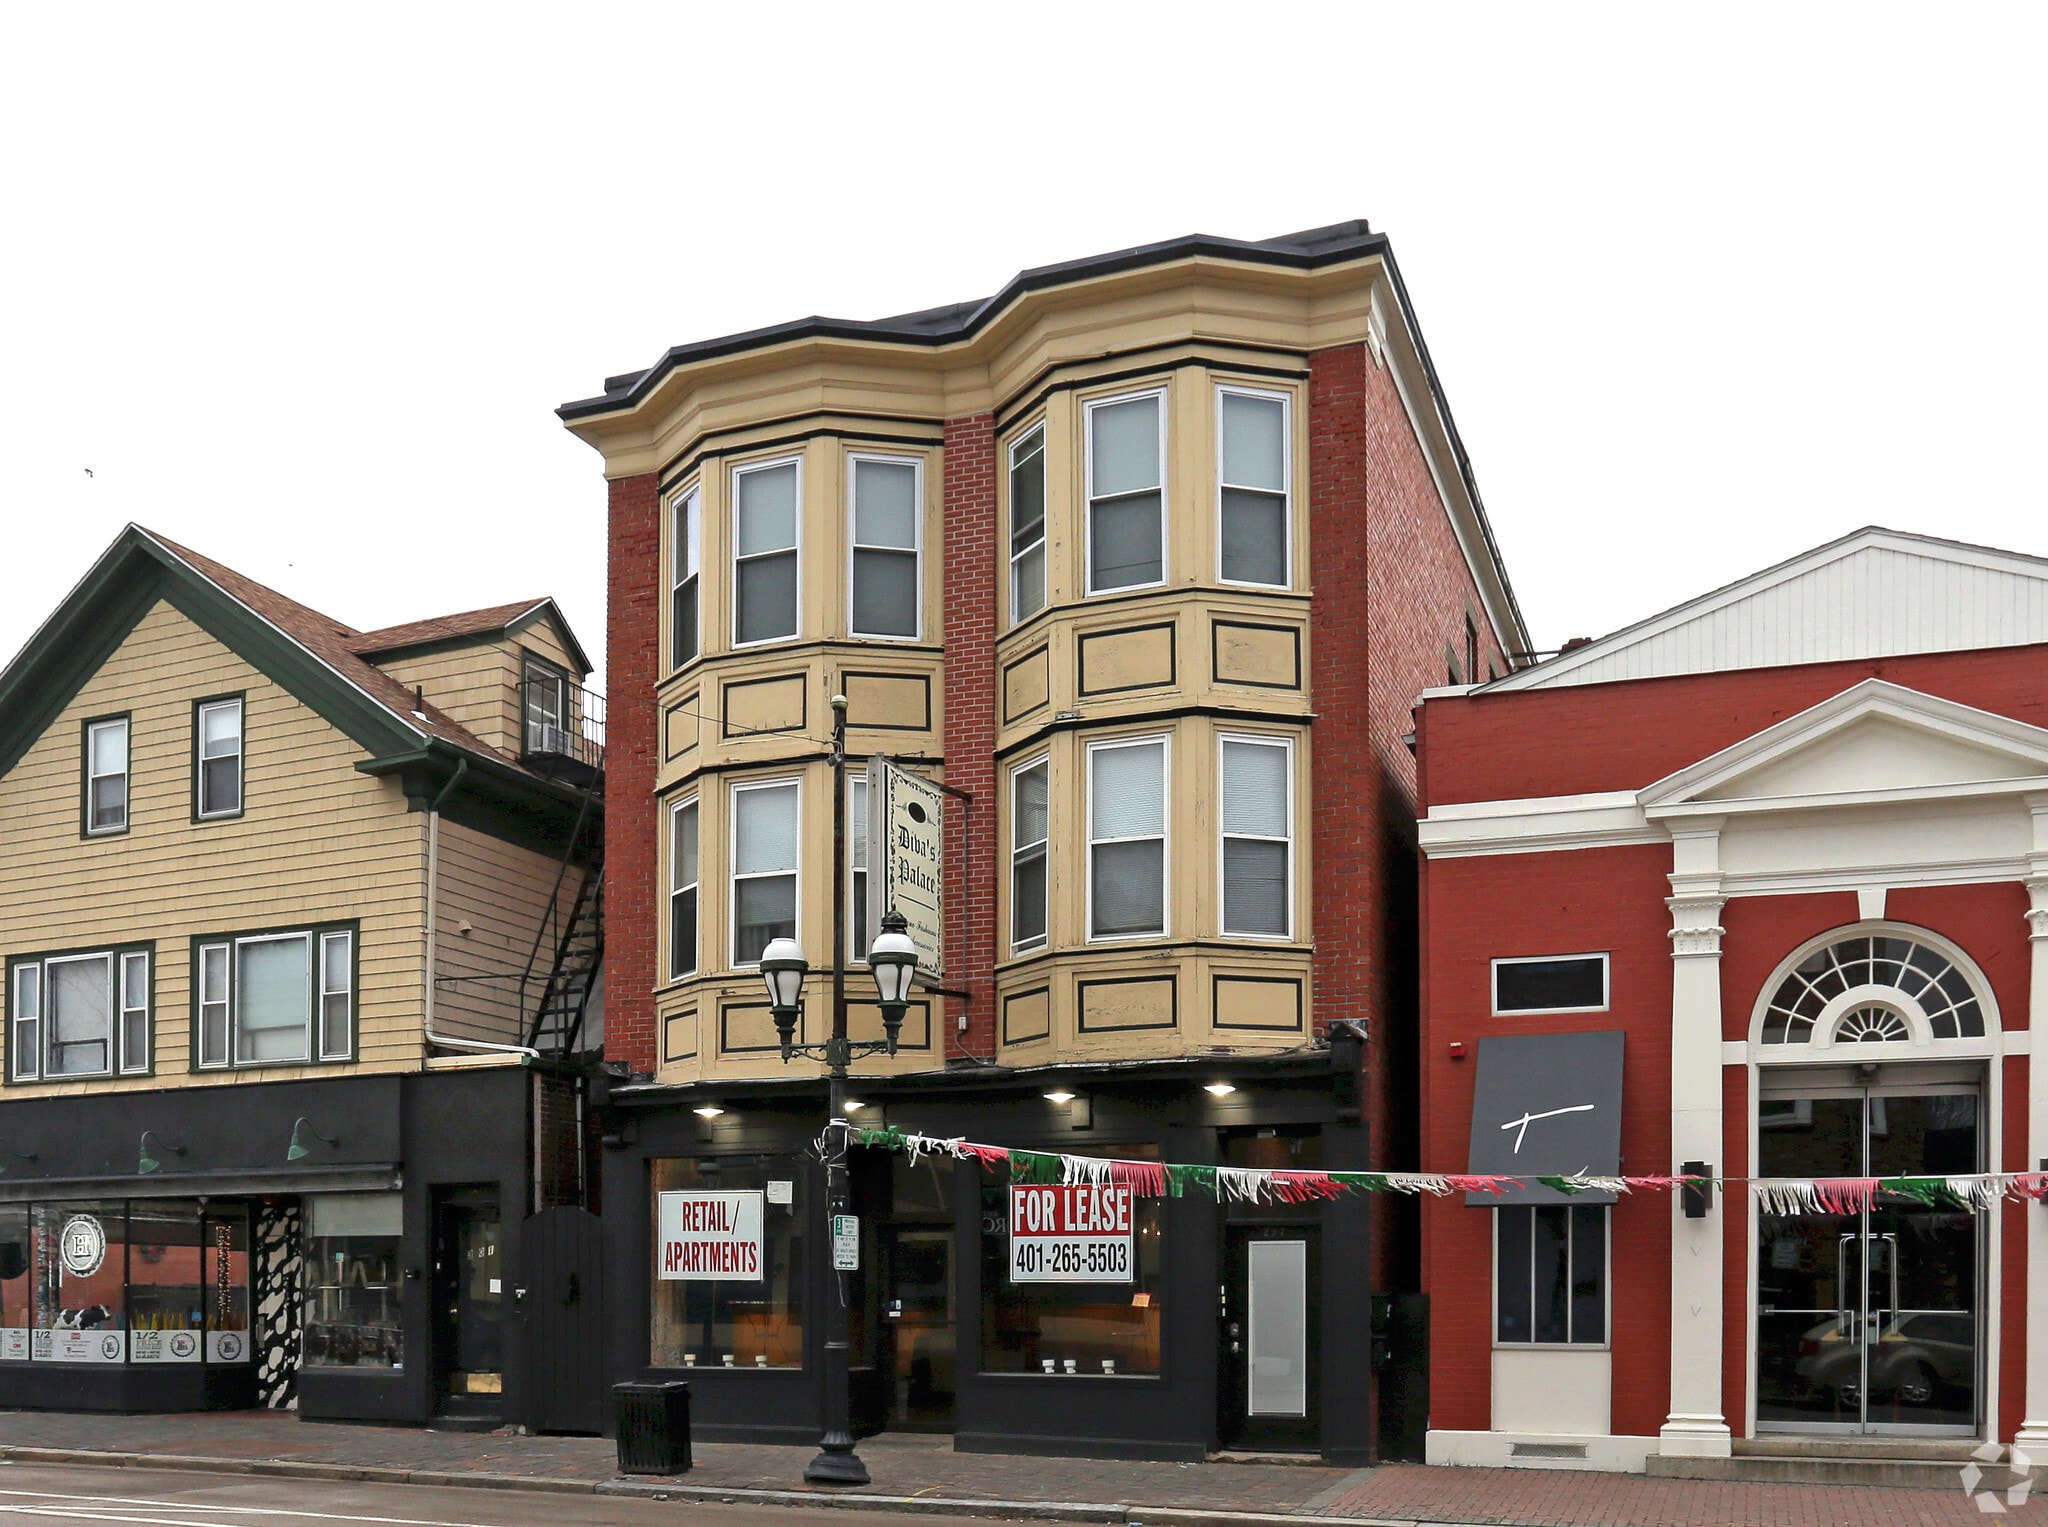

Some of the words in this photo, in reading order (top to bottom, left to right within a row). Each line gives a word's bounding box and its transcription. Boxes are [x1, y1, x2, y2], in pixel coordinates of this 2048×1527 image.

[897, 824, 936, 862] Diva's
[897, 856, 936, 894] Palace
[1014, 1189, 1056, 1233] FOR
[1064, 1188, 1129, 1232] LEASE
[665, 1241, 757, 1273] APARTMENTS
[1016, 1243, 1127, 1273] 401-265-5503
[34, 1330, 51, 1339] 1/2
[136, 1331, 159, 1340] 1/2
